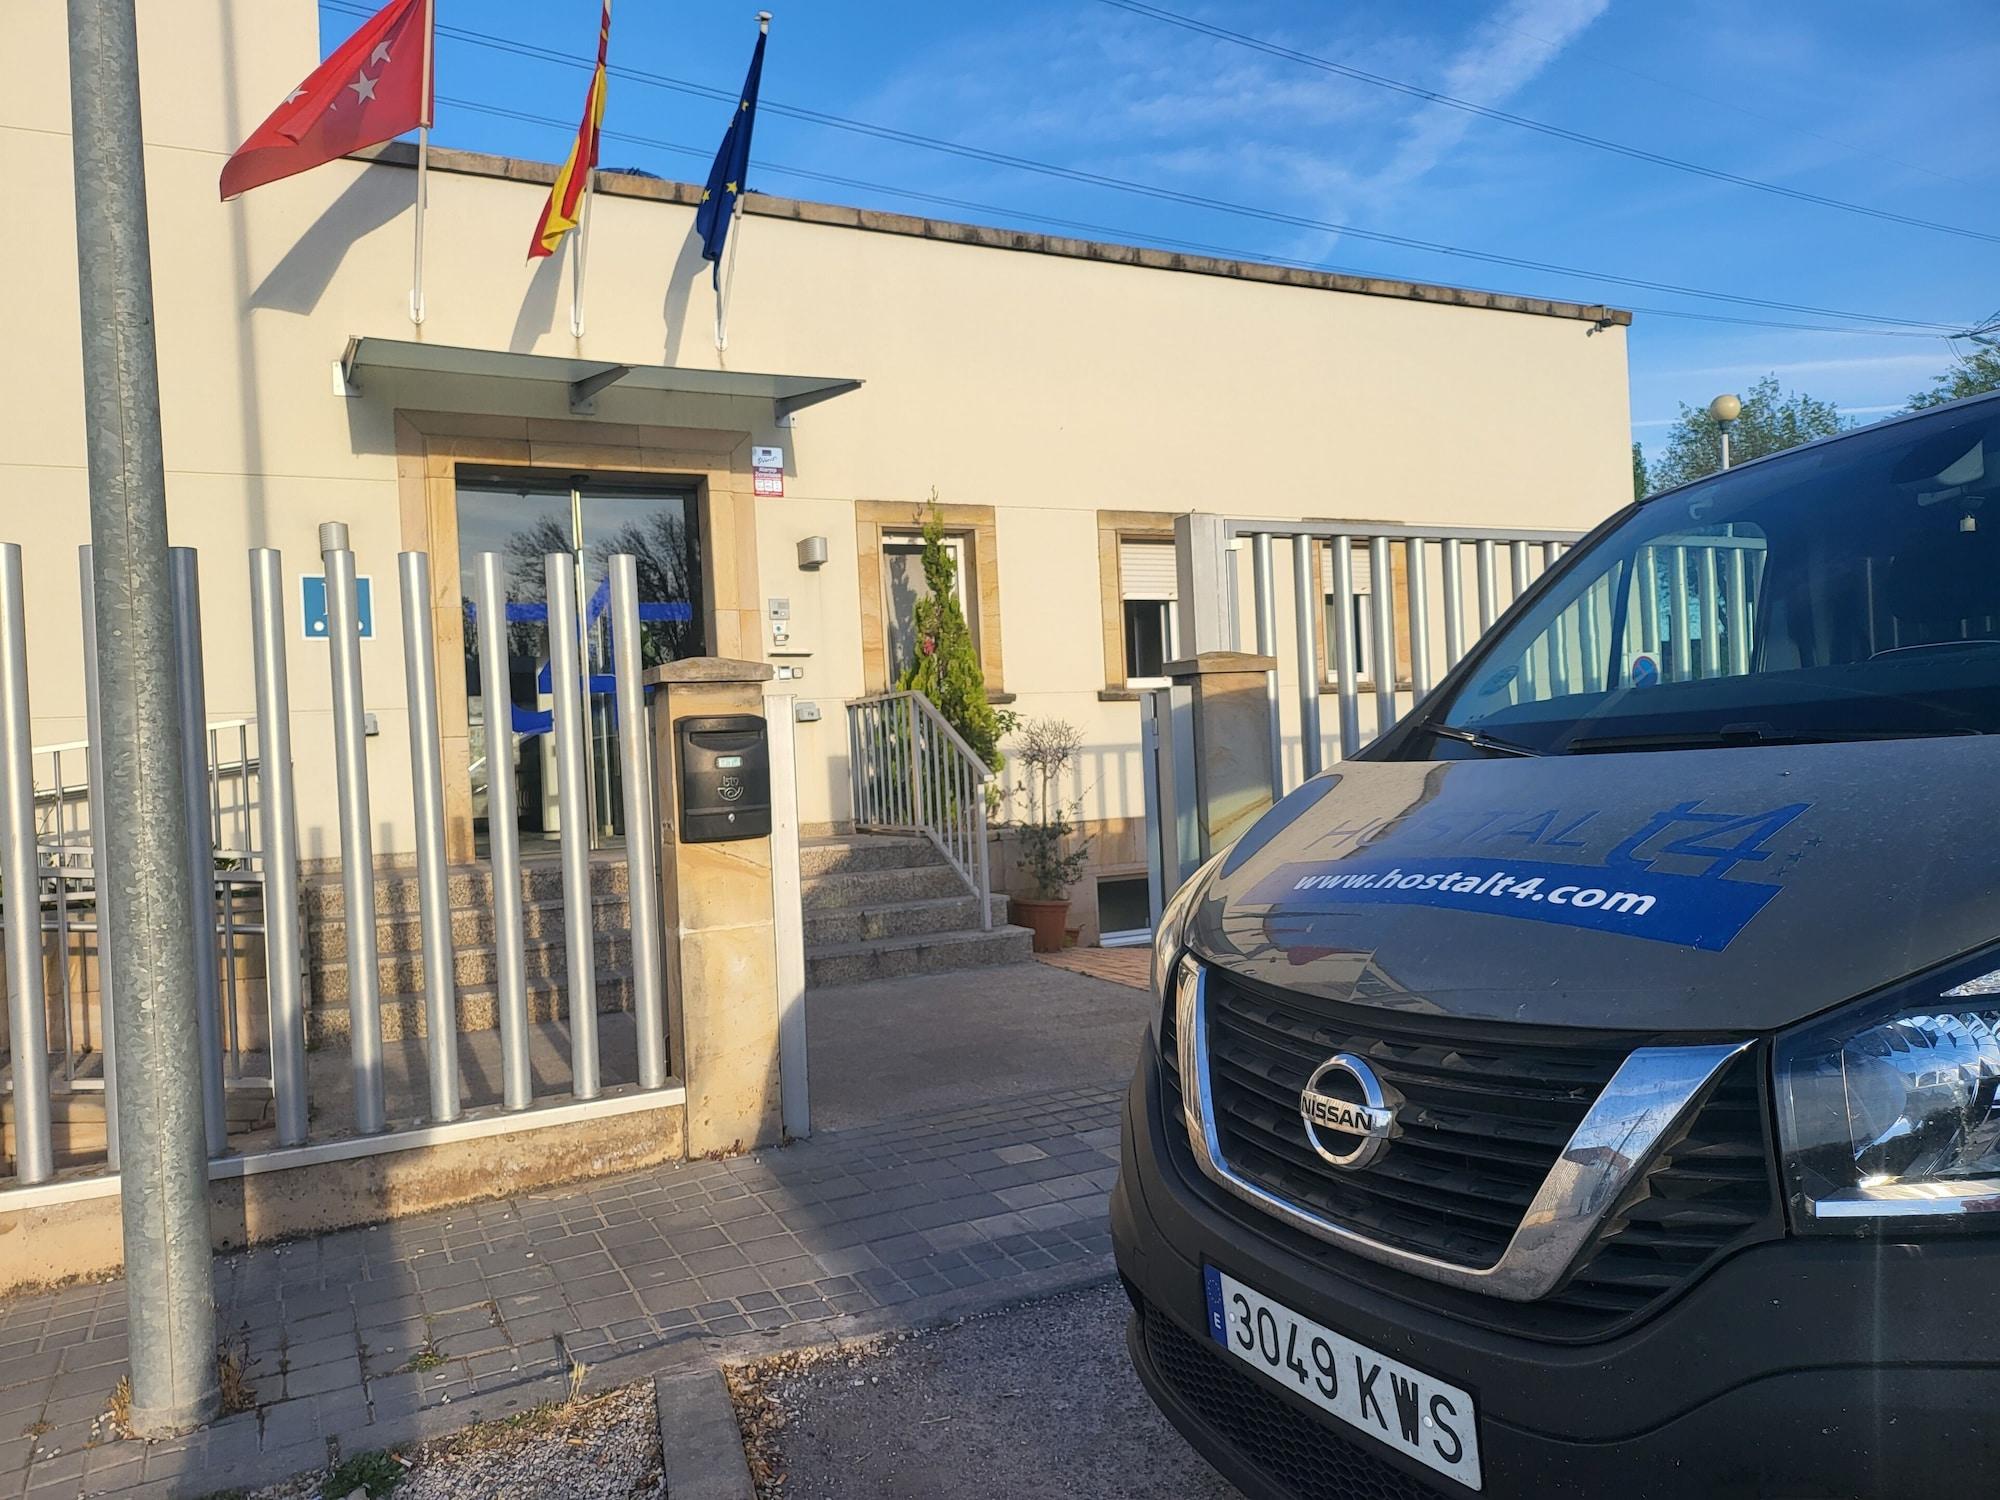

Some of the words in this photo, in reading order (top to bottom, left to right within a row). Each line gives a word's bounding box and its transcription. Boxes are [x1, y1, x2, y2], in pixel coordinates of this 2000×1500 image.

[1302, 809, 1601, 850] HOSTAL
[1604, 799, 1816, 879] t4
[1293, 868, 1657, 916] www.hostalt4.com
[1301, 1095, 1373, 1131] NISSAN
[1213, 1311, 1222, 1330] E
[1232, 1292, 1339, 1400] 3049
[1355, 1355, 1463, 1464] KWS
